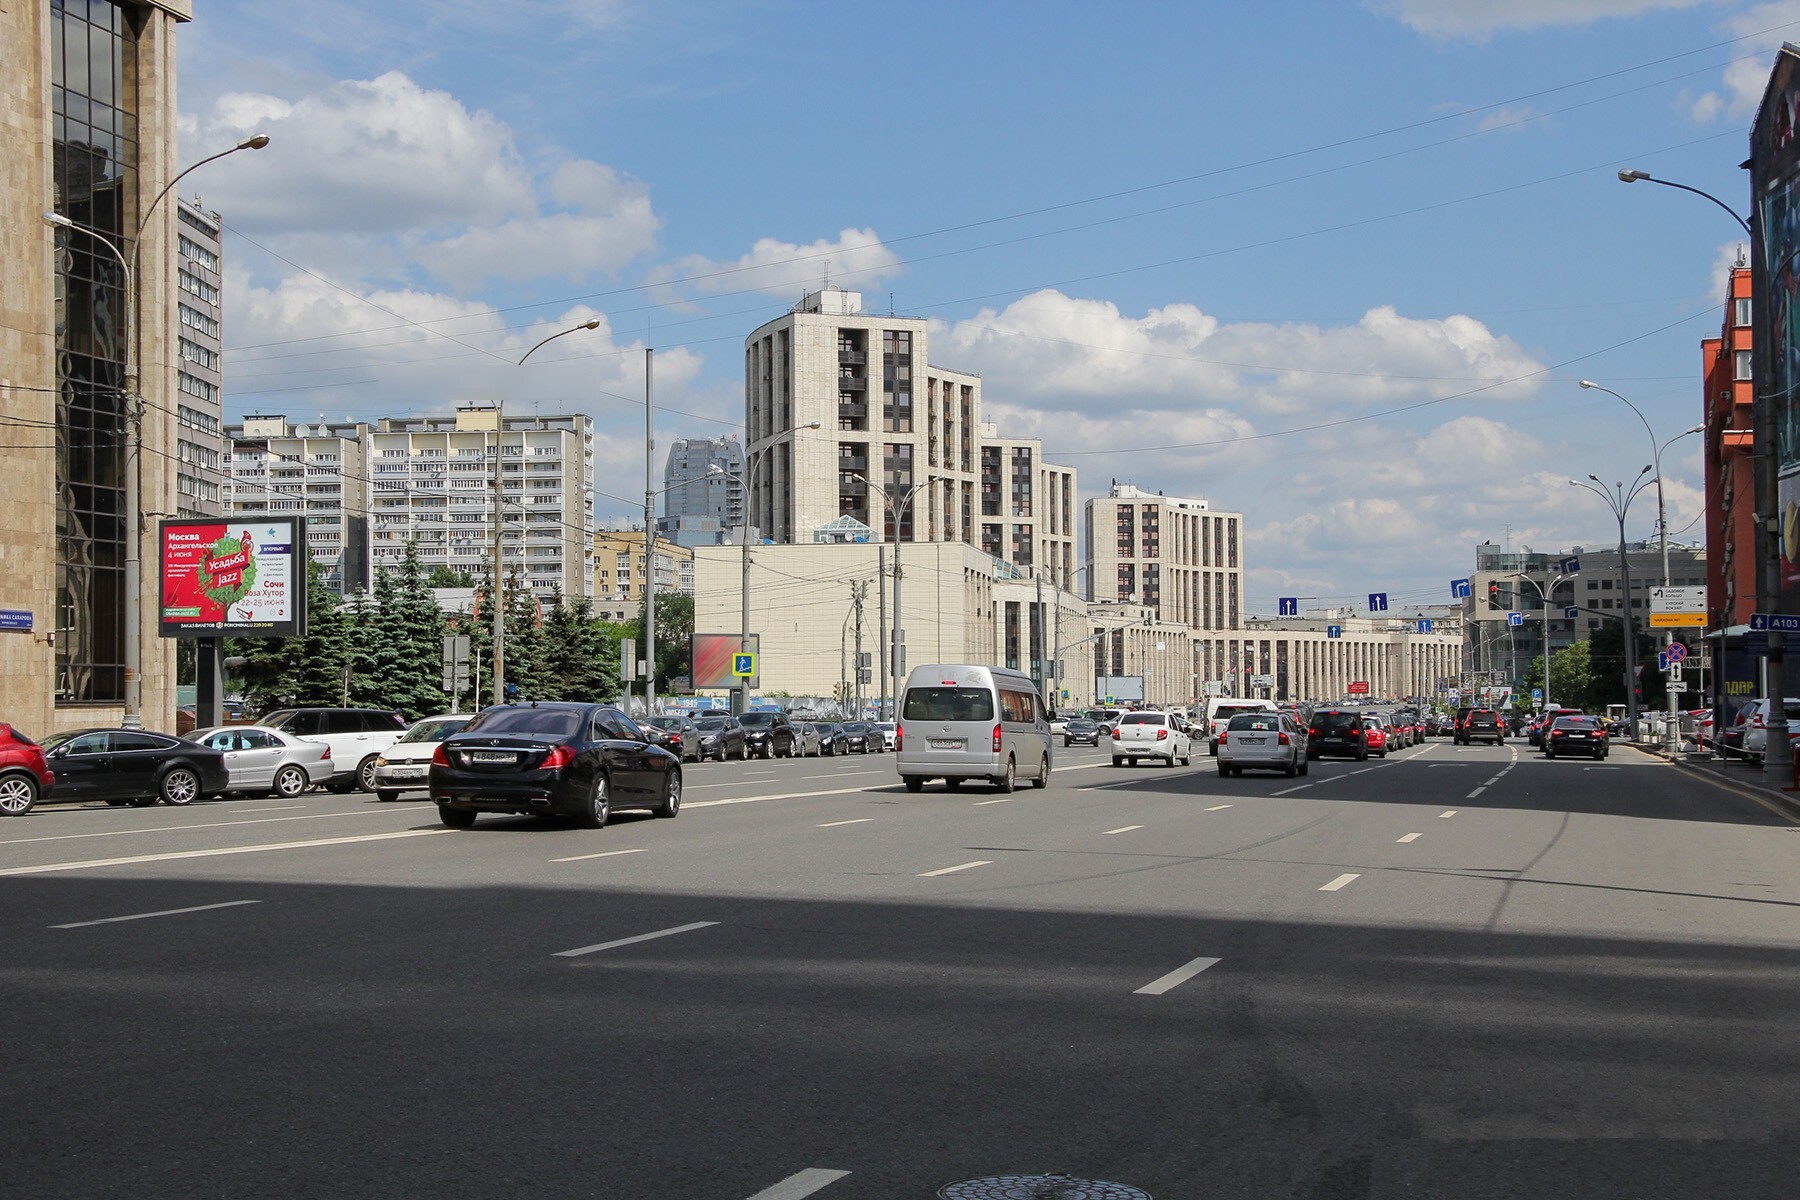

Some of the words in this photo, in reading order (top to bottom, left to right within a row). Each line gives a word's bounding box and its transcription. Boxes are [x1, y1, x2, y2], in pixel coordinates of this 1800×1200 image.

[168, 533, 200, 541] Москва
[168, 542, 219, 550] Архангельское
[209, 552, 245, 570] Усадьба
[217, 572, 238, 588] jazz
[262, 590, 284, 598] Хутор
[241, 600, 262, 608] 22-25
